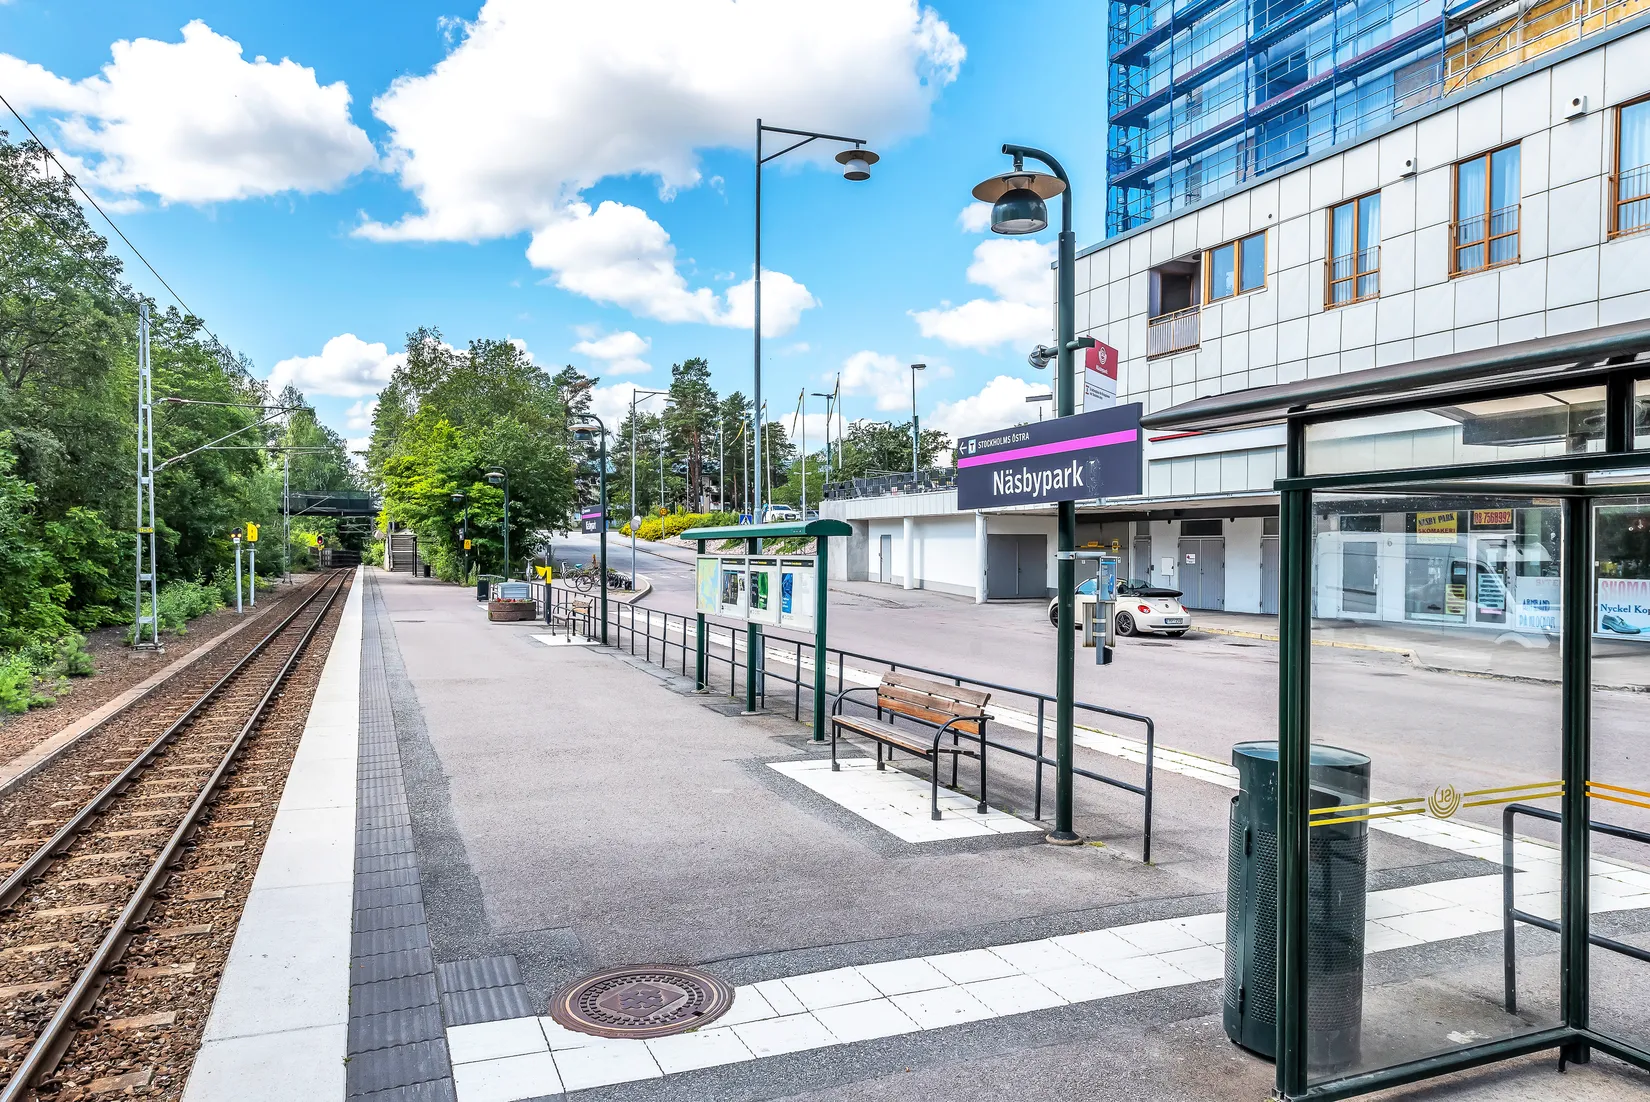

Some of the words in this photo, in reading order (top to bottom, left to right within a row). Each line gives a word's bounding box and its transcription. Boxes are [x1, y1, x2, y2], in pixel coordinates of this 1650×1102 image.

[978, 436, 1011, 449] STOCKHOLMS
[1012, 431, 1030, 443] ÖSTRA
[993, 459, 1084, 497] Näsbypark
[1437, 513, 1455, 523] PARK
[1387, 537, 1393, 547] 6
[1601, 580, 1650, 598] SKOMA
[1600, 603, 1631, 613] Nyckel
